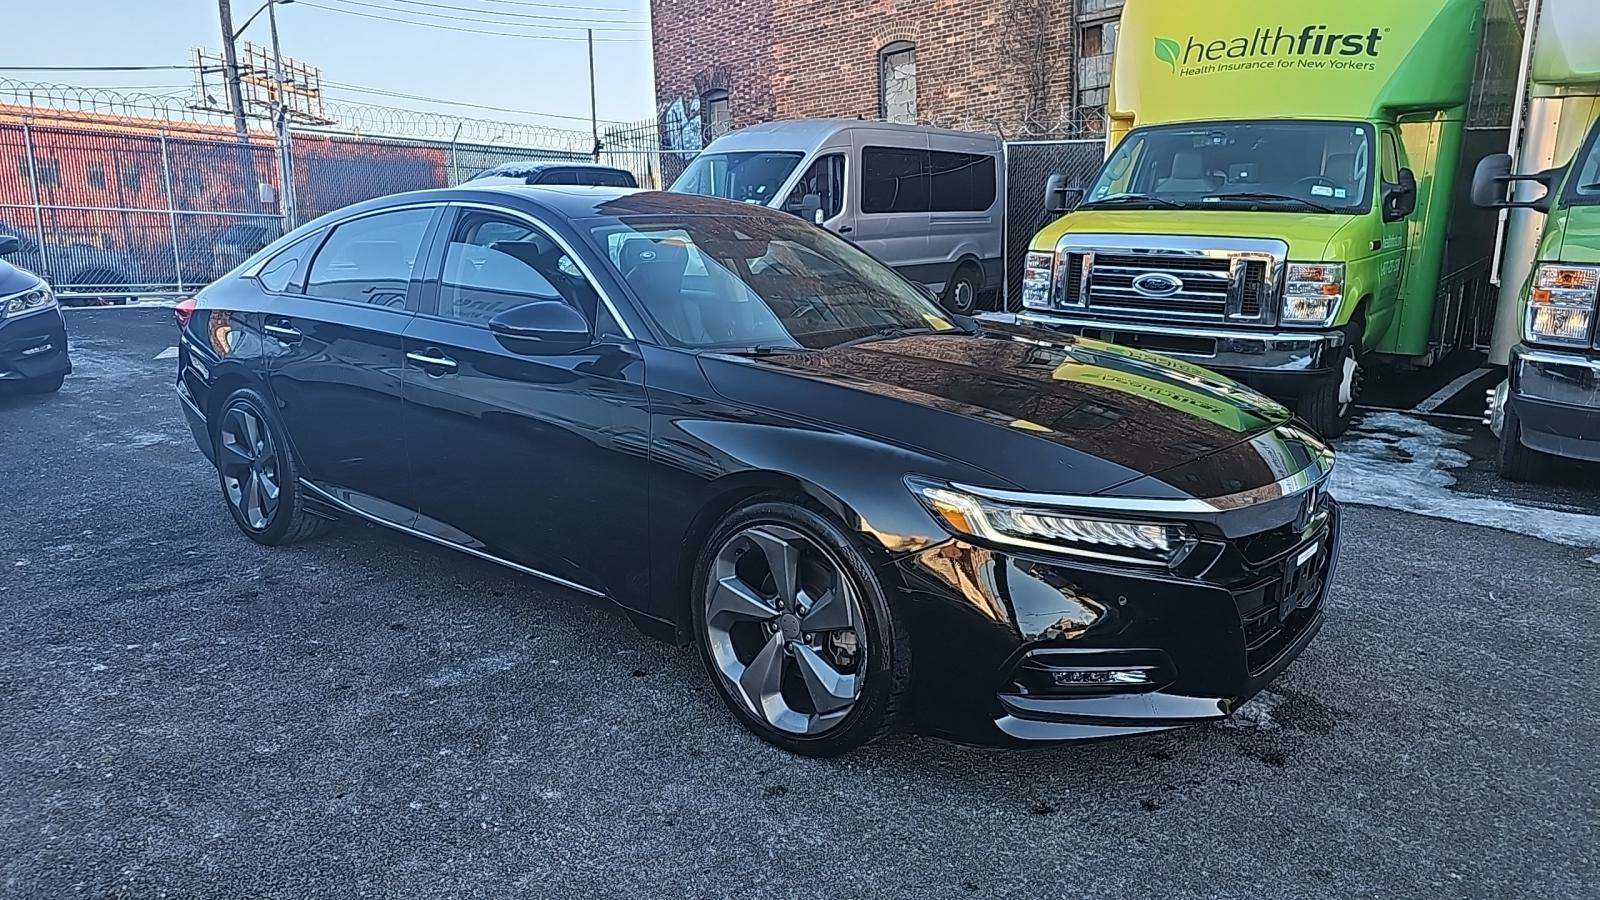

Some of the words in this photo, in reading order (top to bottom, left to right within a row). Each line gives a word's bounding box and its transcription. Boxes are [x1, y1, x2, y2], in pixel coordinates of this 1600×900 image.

[1183, 25, 1382, 64] healthfirst
[1180, 64, 1215, 76] Health
[1217, 60, 1274, 72] Insurance
[1277, 59, 1295, 68] for
[1298, 60, 1326, 69] New
[1329, 60, 1375, 71] Yorkers
